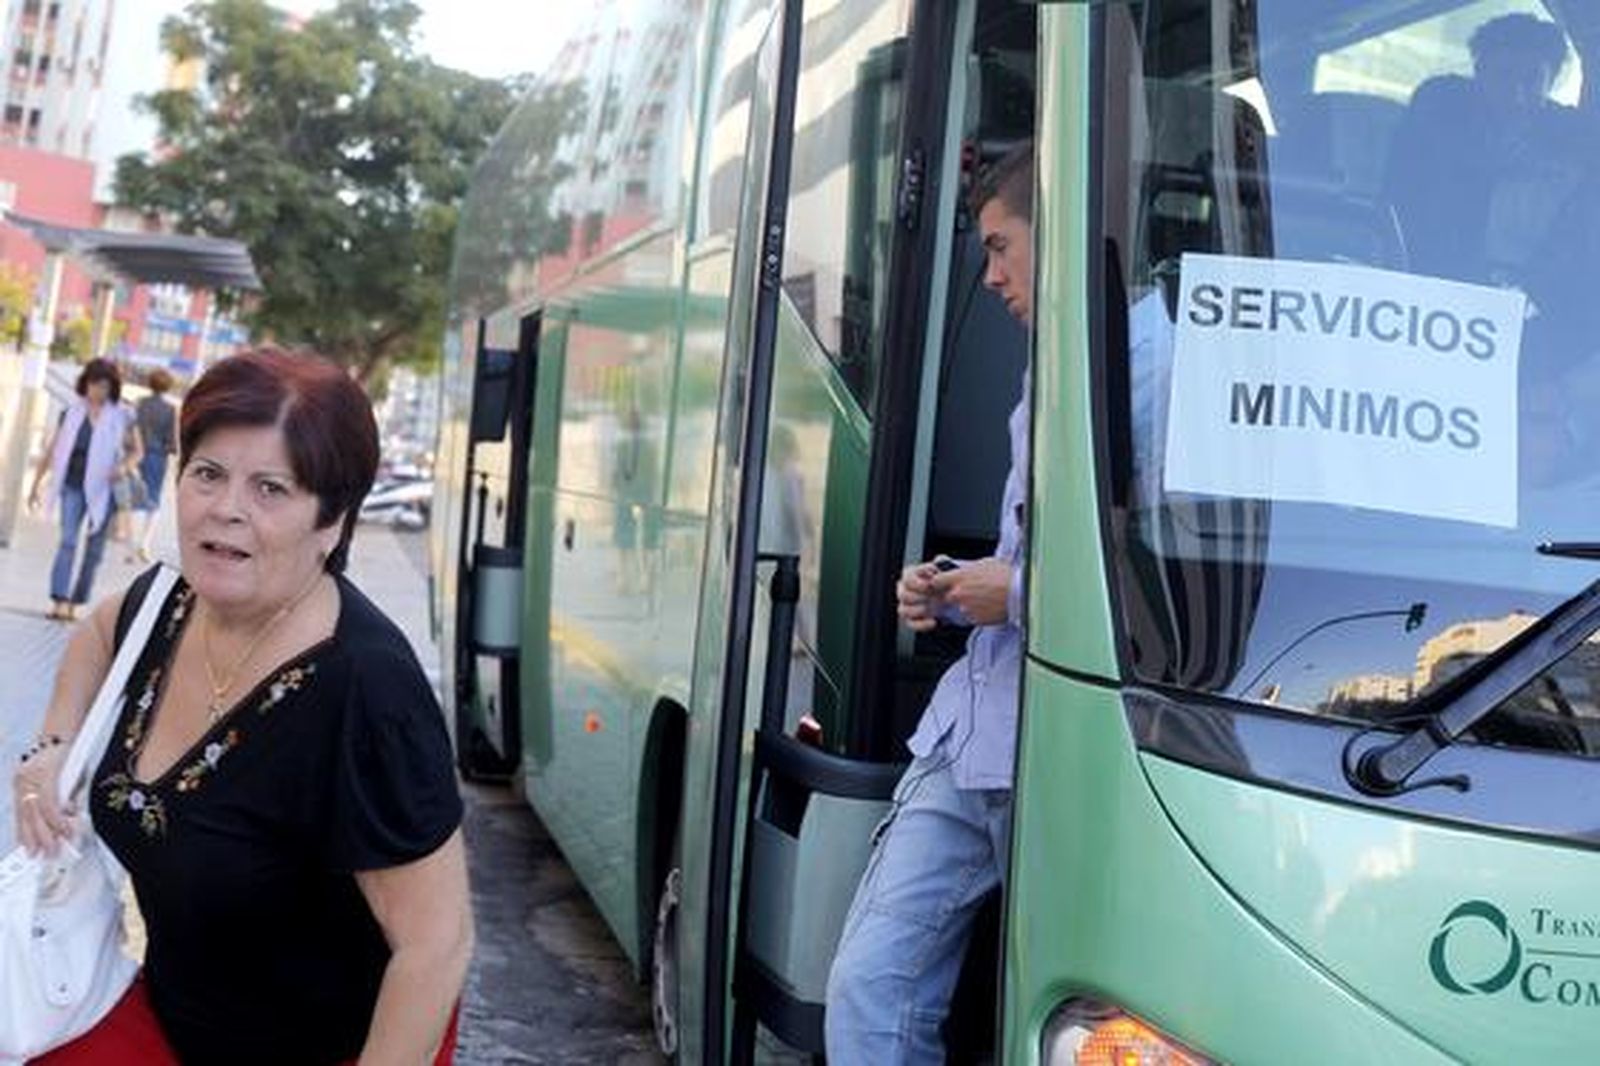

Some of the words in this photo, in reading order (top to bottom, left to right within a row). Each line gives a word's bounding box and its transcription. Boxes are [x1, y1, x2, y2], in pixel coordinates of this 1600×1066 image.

[1188, 284, 1498, 361] SERVICIOS
[1229, 381, 1481, 450] MINIMOS
[1531, 908, 1600, 938] TRAN
